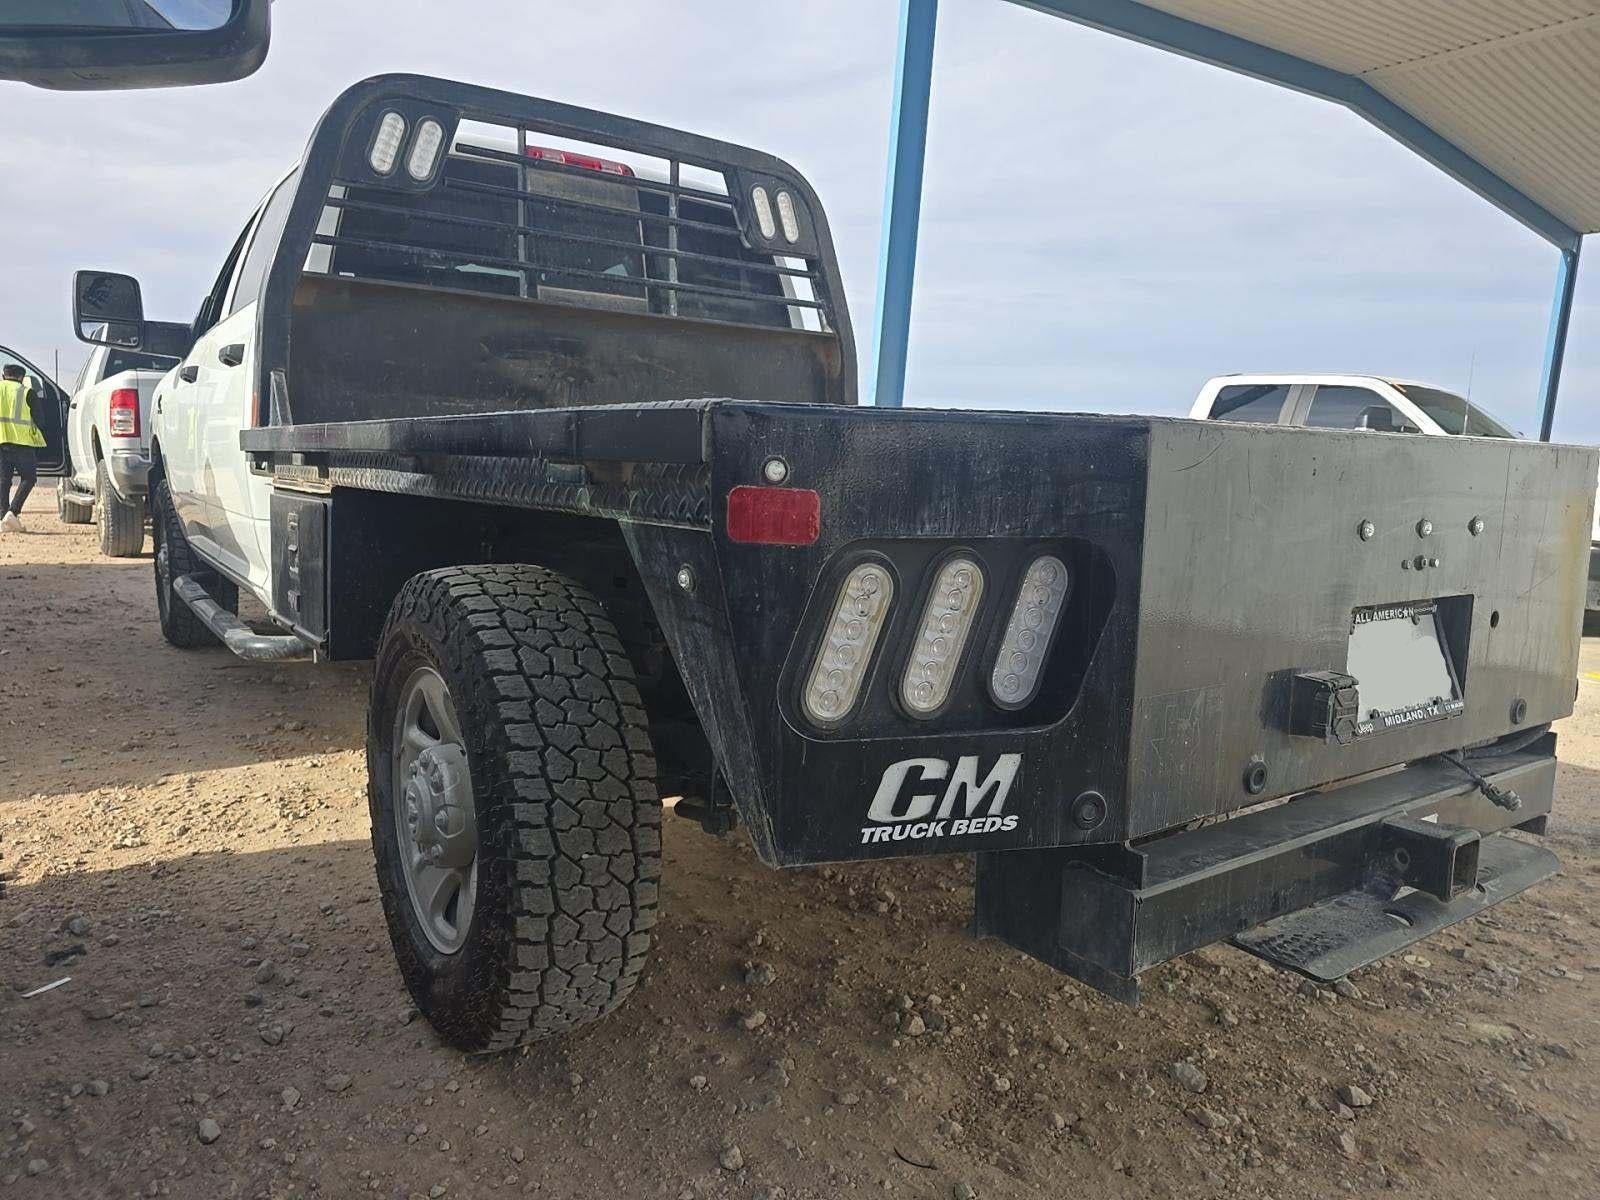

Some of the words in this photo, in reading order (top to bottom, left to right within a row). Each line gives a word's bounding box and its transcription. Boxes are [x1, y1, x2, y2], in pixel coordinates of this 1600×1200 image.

[1355, 612, 1371, 624] ALL
[1428, 705, 1439, 716] TX
[867, 753, 1024, 822] CM
[860, 820, 948, 844] TRUCK
[950, 815, 1019, 836] BEDS
